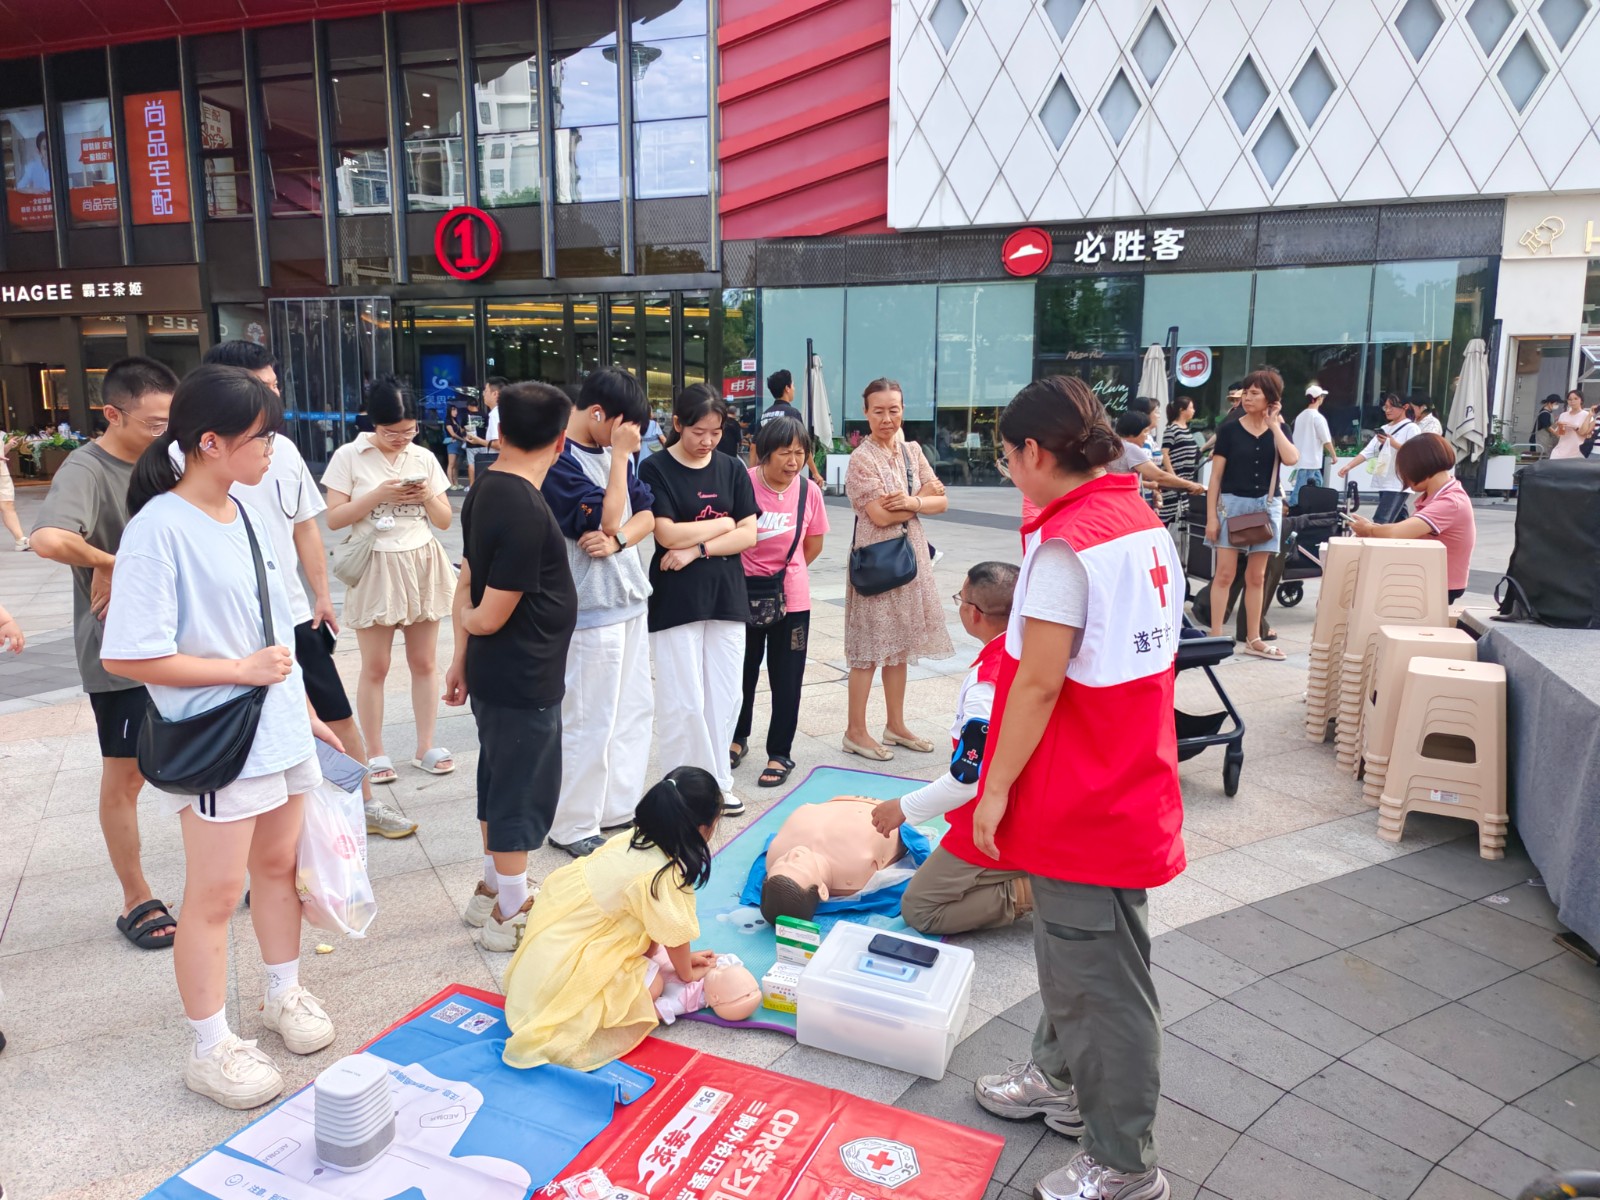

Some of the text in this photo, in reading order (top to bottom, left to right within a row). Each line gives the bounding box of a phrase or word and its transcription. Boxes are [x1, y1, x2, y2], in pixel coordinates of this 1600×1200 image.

[143, 99, 174, 217] 尚品宅配
[453, 219, 481, 268] 1
[1074, 227, 1186, 264] 必胜客
[2, 281, 143, 302] HAGEE 霸王茶姬
[646, 1115, 697, 1167] 一等奖
